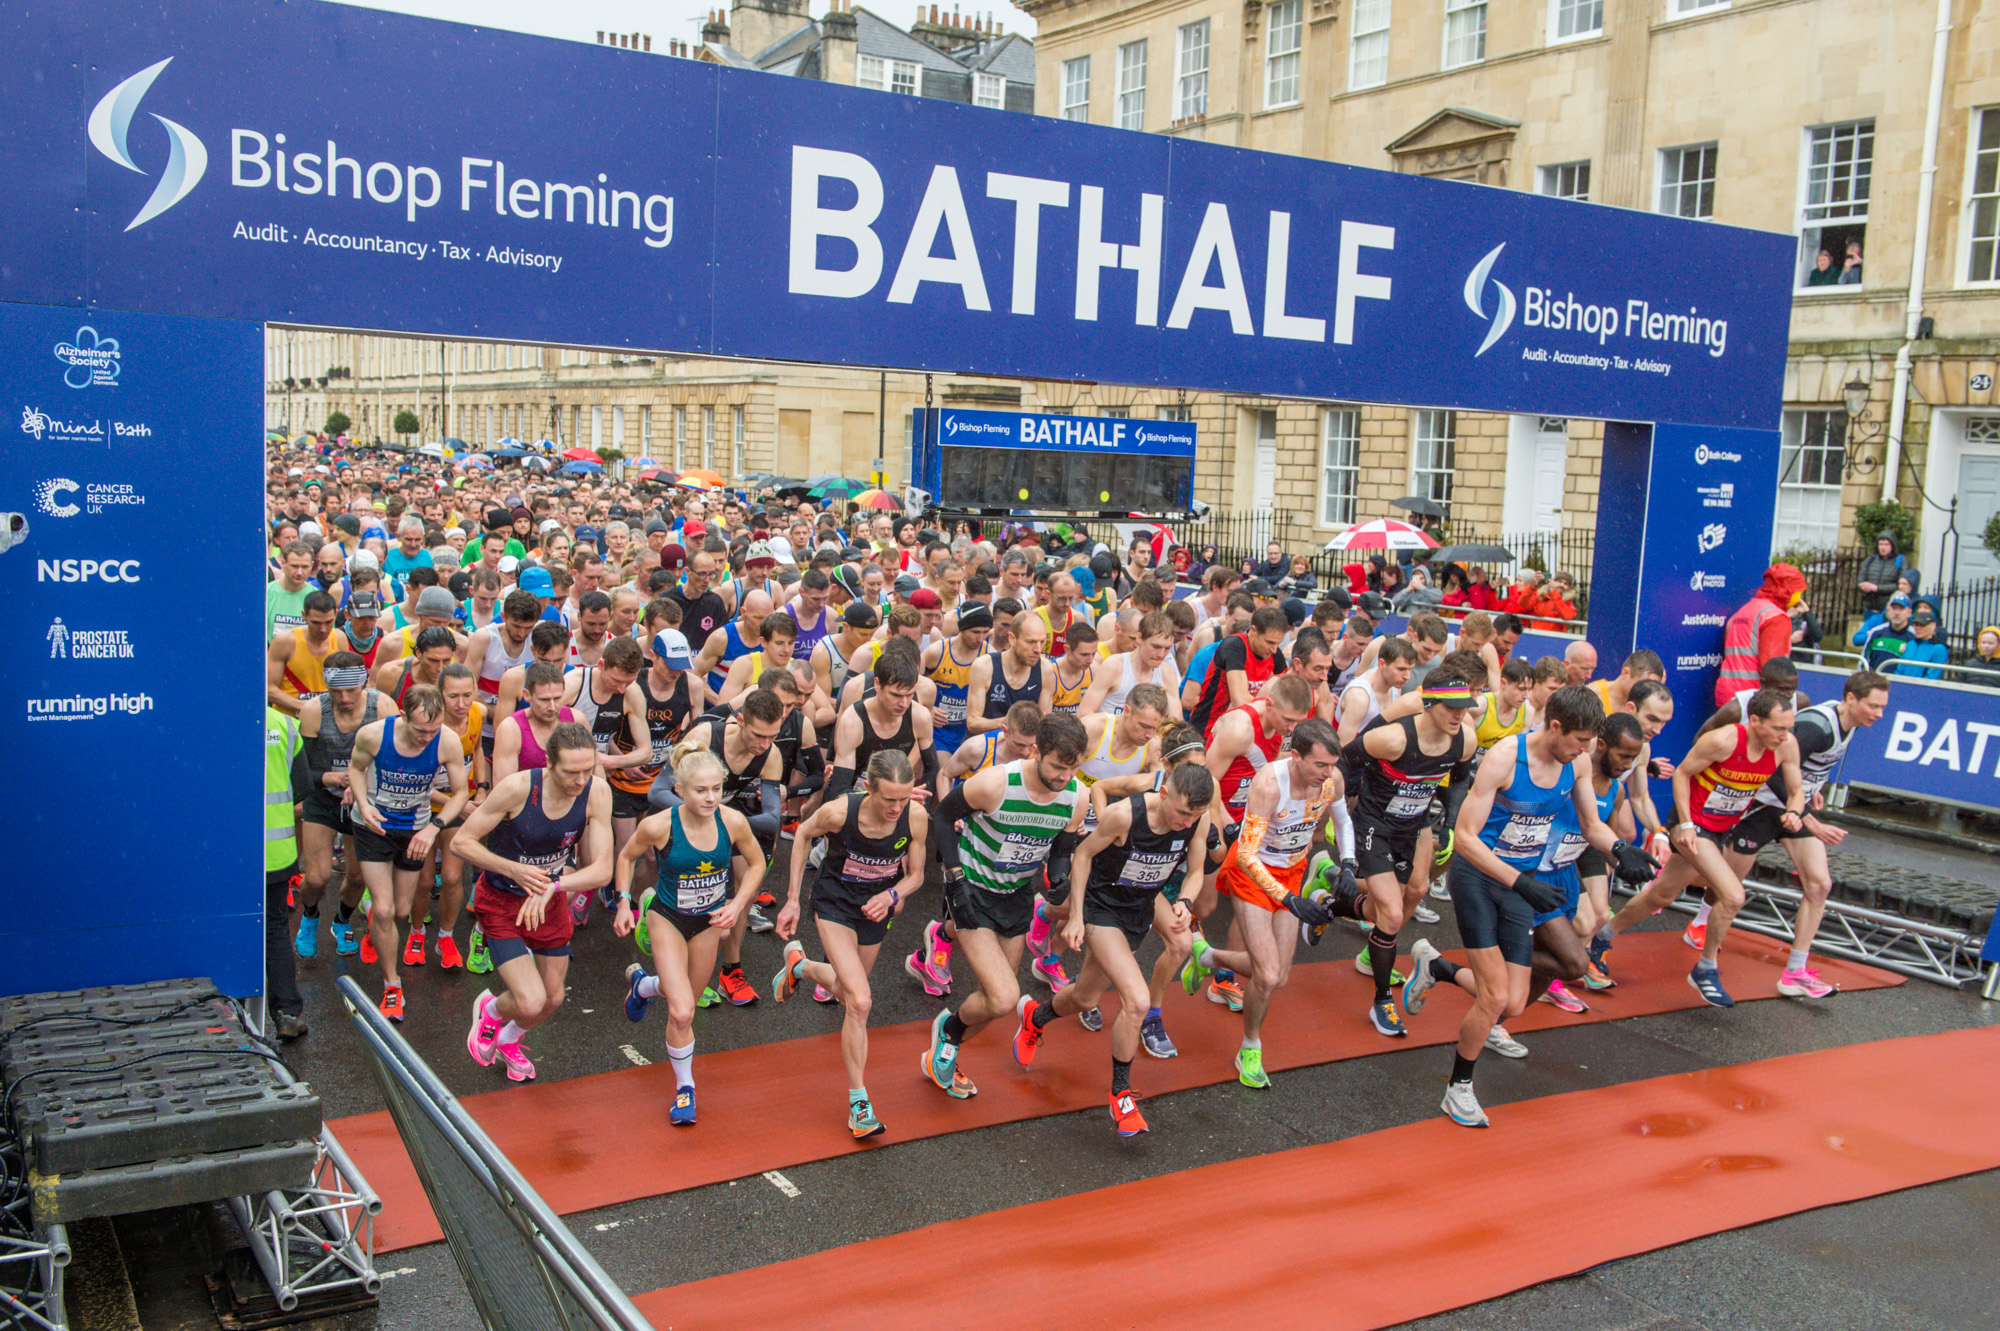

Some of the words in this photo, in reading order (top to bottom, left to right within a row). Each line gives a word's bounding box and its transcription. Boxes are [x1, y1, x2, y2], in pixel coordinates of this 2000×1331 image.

[231, 128, 441, 222] Bishop
[461, 155, 675, 248] Fleming
[233, 221, 288, 243] Audit
[303, 227, 428, 260] Accountancy
[439, 240, 470, 260] Tax
[486, 245, 562, 273] Advisory
[788, 144, 1396, 345] BATHALF
[1524, 287, 1619, 345] Bishop
[1625, 299, 1728, 357] Fleming
[58, 346, 121, 359] Alzheimer's
[69, 356, 110, 369] Society
[1522, 347, 1548, 362] Audit
[1553, 350, 1609, 370] Accountancy
[1613, 356, 1629, 369] Tax
[1634, 358, 1671, 376] Advisory
[1971, 376, 1990, 389] 24
[49, 419, 105, 434] mind
[114, 422, 152, 437] Bath
[959, 422, 983, 434] Bishop
[983, 424, 1010, 436] Fleming
[1020, 418, 1126, 447] BATHALF
[1147, 433, 1168, 445] Bishop
[1168, 434, 1192, 446] Fleming
[87, 483, 133, 494] CANCER
[87, 494, 145, 504] RESEARCH
[87, 505, 103, 514] UK
[38, 559, 140, 583] NSPCC
[276, 615, 307, 625] BATHAL
[1682, 614, 1725, 627] JustGiving
[72, 631, 128, 645] PROSTATE
[72, 644, 117, 658] CANCER
[118, 644, 134, 658] UK
[1677, 653, 1706, 667] running
[1706, 653, 1723, 667] high
[27, 694, 107, 715] running
[110, 693, 153, 714] high
[48, 713, 94, 722] Management
[948, 711, 963, 720] 218
[1884, 710, 2000, 778] BAT
[381, 769, 433, 781] BEDFORD
[381, 782, 427, 794] BATHALF
[1715, 784, 1756, 798] BATHALF
[394, 800, 408, 808] 78
[1400, 804, 1418, 813] 437
[1720, 802, 1735, 810] 31
[999, 813, 1045, 824] WOODFORD
[1510, 813, 1556, 824] BATHALF
[1290, 836, 1299, 845] 5
[1518, 834, 1535, 844] 30
[520, 848, 569, 865] BATHALF
[849, 853, 901, 866] BATHALF
[1011, 851, 1034, 863] 349
[1131, 853, 1180, 864] BATHALF
[679, 869, 728, 889] BATHALF
[1137, 871, 1160, 881] 350
[697, 894, 714, 906] 37
